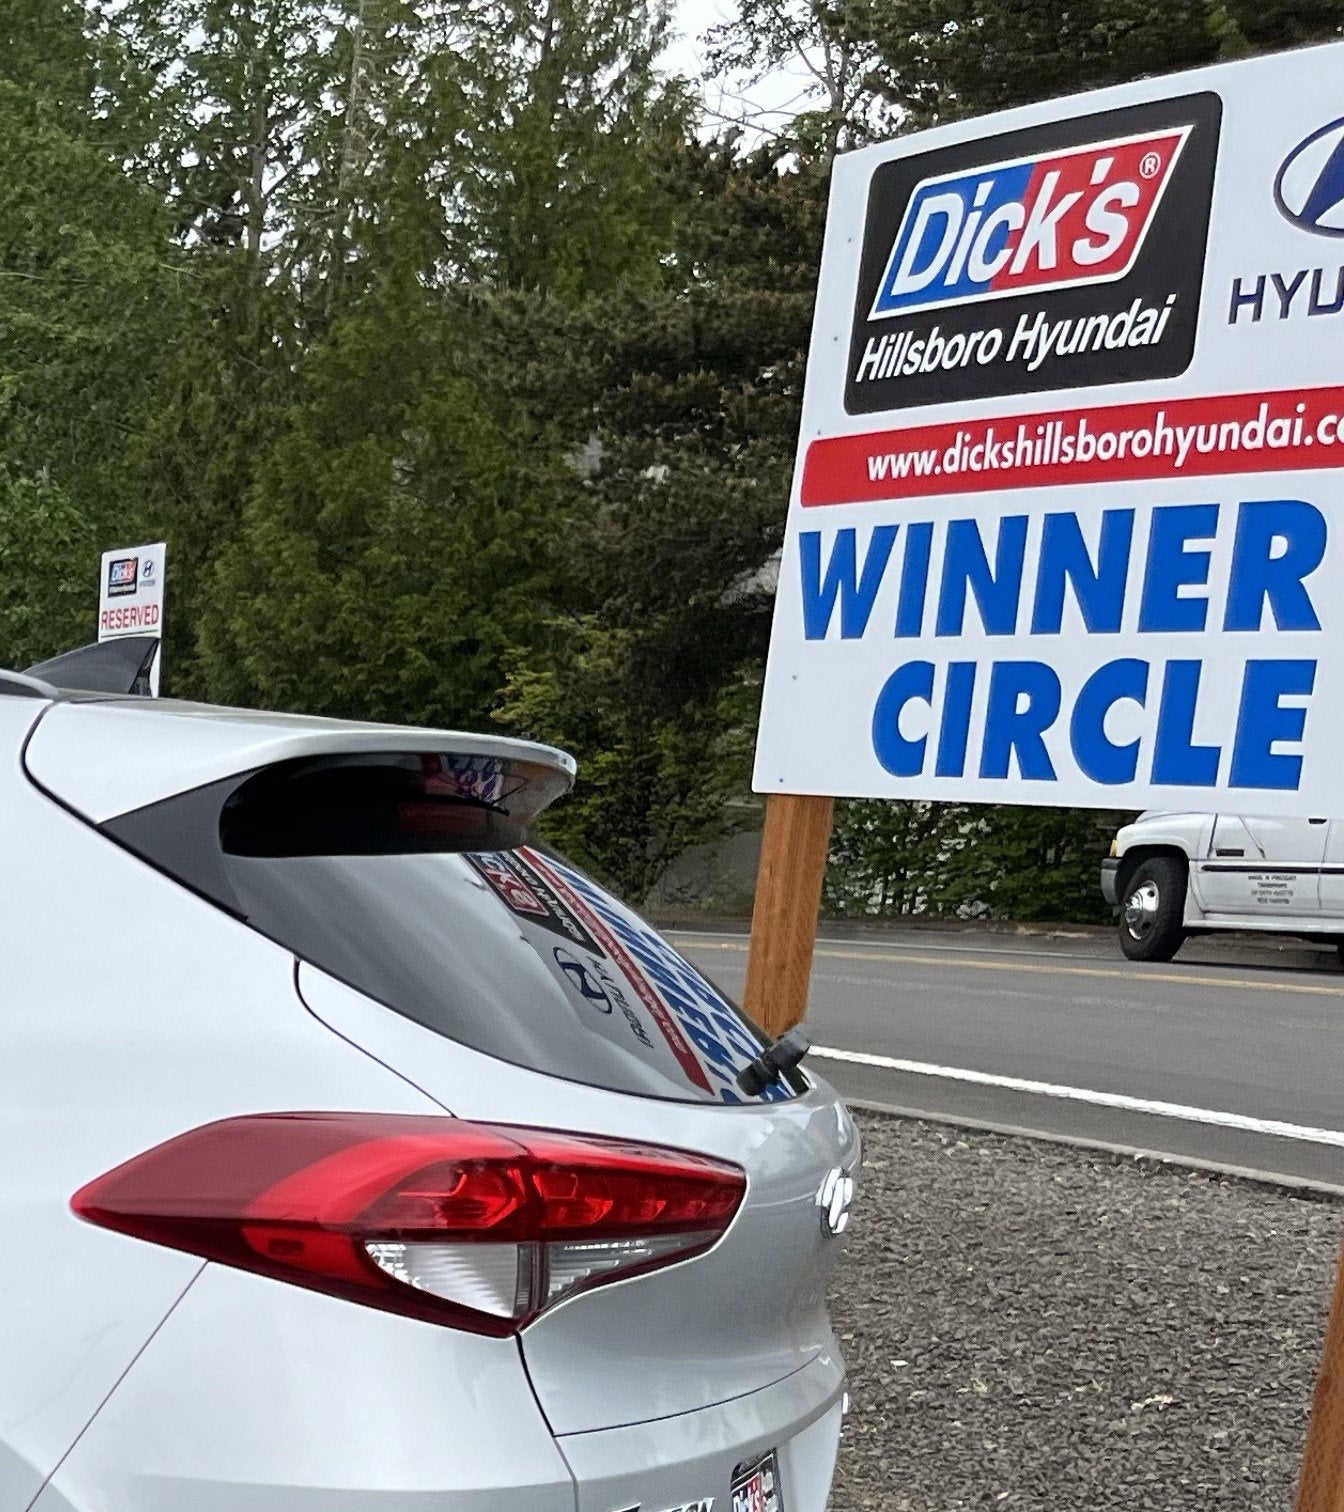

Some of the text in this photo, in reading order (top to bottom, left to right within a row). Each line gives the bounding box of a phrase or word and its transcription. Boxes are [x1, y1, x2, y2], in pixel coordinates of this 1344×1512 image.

[891, 156, 1140, 296] Dick's
[855, 294, 1176, 382] Hillsboro Hyundai
[101, 604, 159, 630] RESERVED
[798, 500, 1327, 640] WINNER
[871, 658, 1317, 791] CIRCLE
